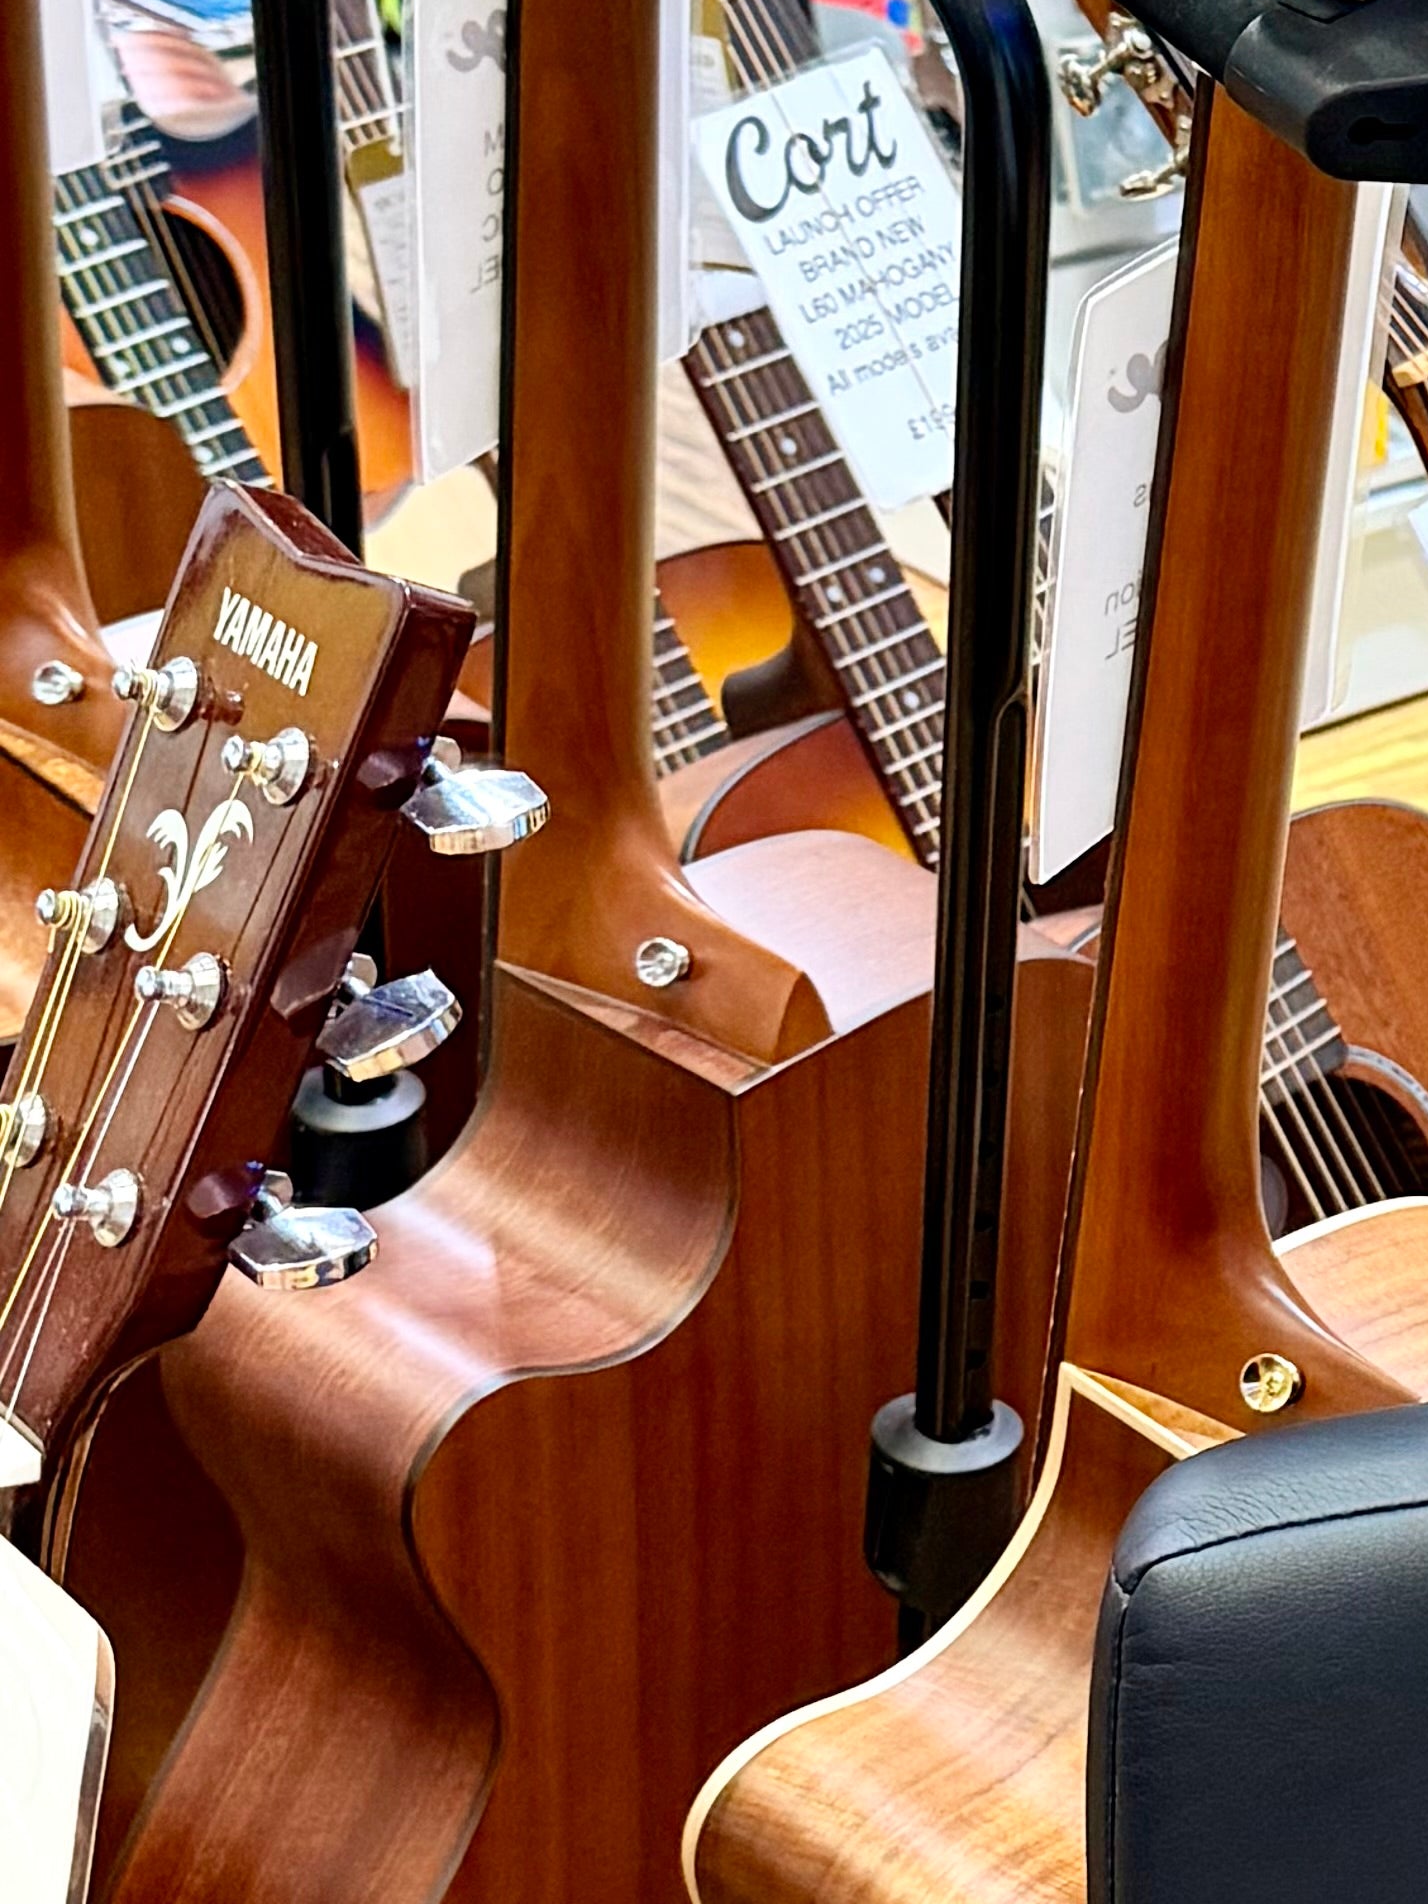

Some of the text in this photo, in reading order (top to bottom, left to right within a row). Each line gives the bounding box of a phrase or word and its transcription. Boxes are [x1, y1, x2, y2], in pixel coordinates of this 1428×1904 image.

[725, 79, 898, 224] Cort
[763, 174, 926, 257] LAUNCH OFFER
[798, 213, 927, 284] BRAND NEW
[839, 241, 958, 310] MAHOGANY
[833, 311, 886, 352] 2025
[213, 586, 320, 698] YAMAHA
